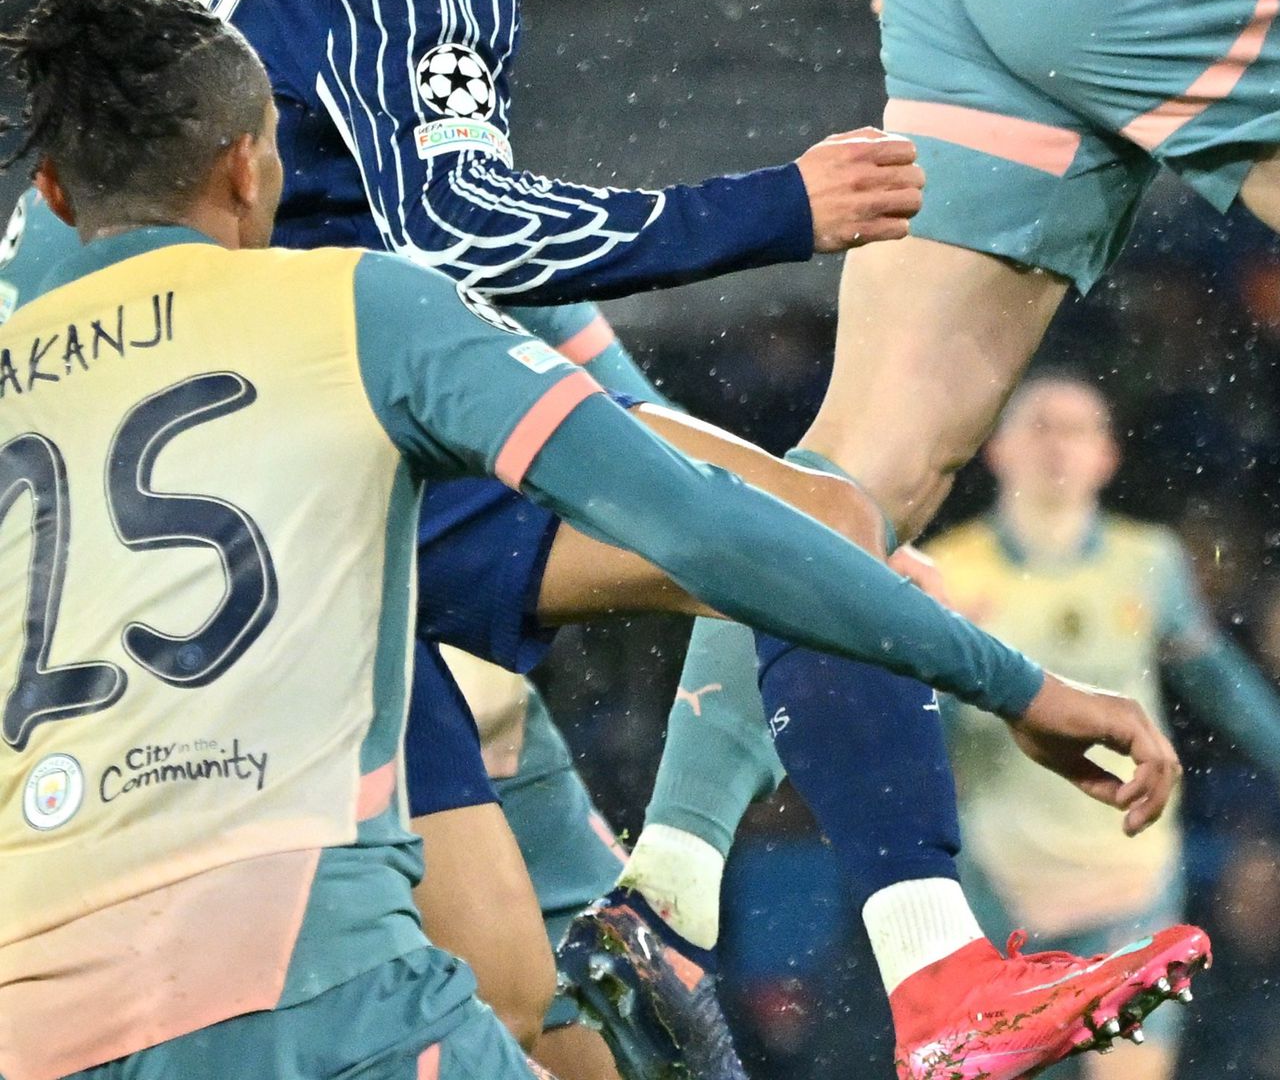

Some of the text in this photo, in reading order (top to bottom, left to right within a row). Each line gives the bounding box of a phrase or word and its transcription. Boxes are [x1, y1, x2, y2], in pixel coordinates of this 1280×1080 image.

[0, 291, 174, 399] AKANJI
[0, 370, 279, 752] 25
[100, 738, 268, 804] Community
[125, 742, 176, 771] City
[193, 738, 218, 752] the
